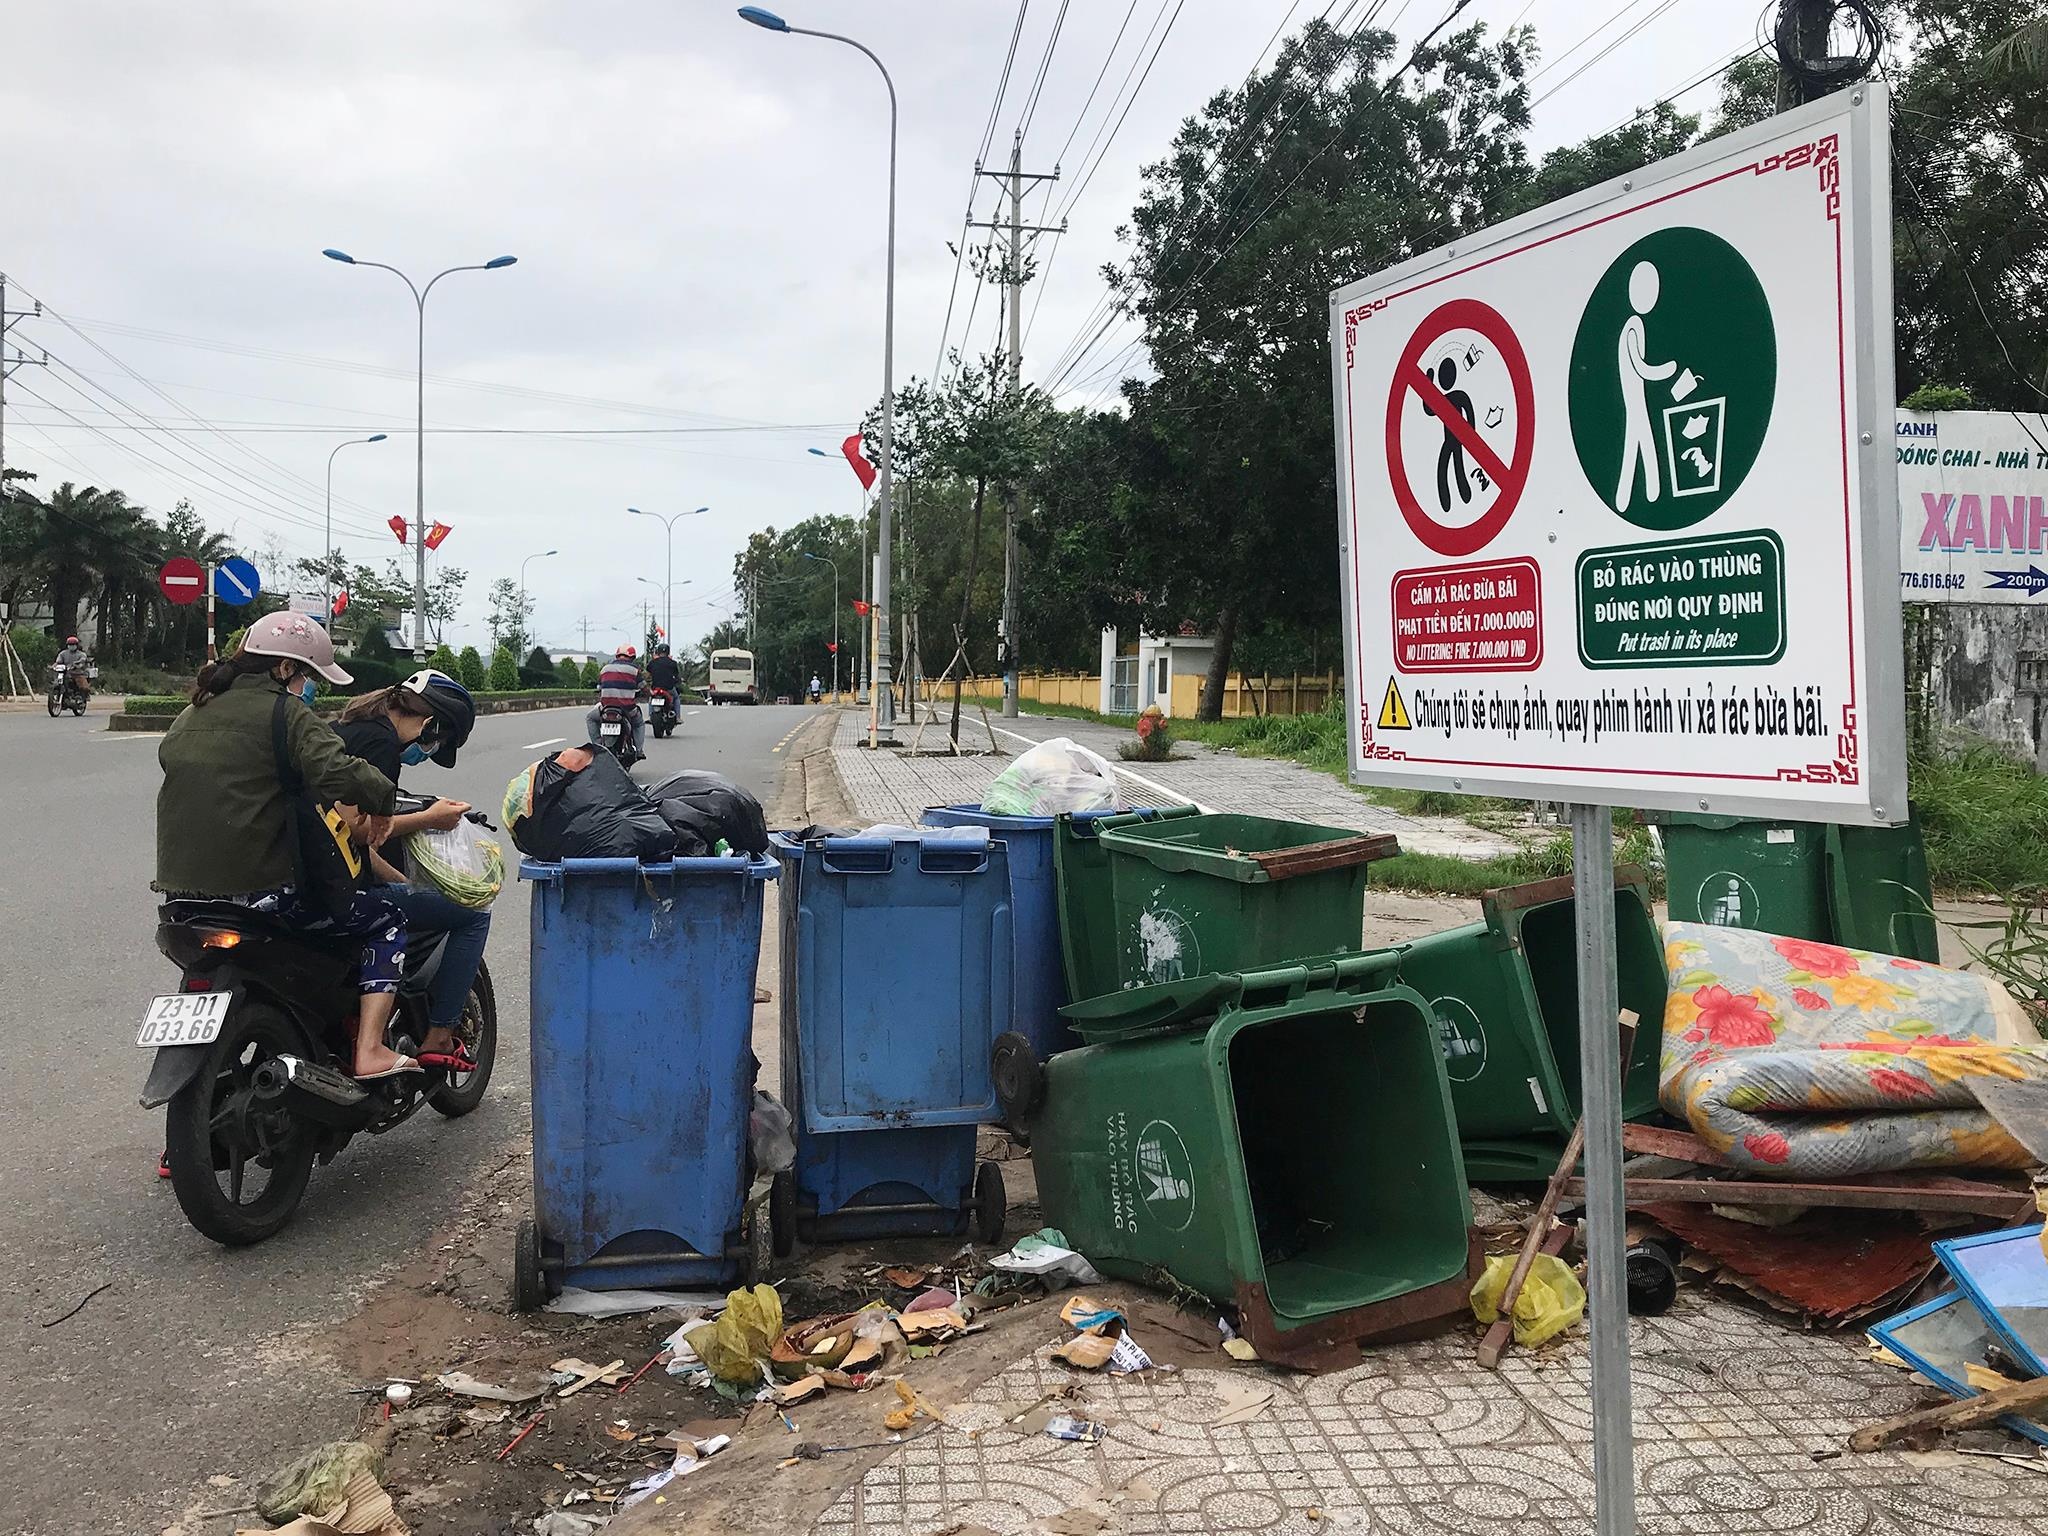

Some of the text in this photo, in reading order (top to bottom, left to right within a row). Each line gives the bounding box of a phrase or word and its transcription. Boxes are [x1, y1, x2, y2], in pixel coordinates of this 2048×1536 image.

[1942, 449, 1981, 467] CHAI
[1995, 447, 2028, 469] NHÀ
[1918, 492, 2048, 554] XANH
[1593, 550, 1762, 588] BỎ RÁC VÀO THÙNG
[2007, 575, 2046, 587] 200m
[1410, 575, 1518, 605] CẤM XẢ RÁC BỪA BÃI
[1594, 591, 1763, 623] ĐÚNG NƠI QUY ĐỊNH
[1398, 608, 1535, 639] PHẠT TIỀN ĐẾN 7.000.000Đ
[1406, 644, 1416, 661] NO
[1417, 643, 1454, 660] LITTERING!
[1454, 642, 1472, 659] FINE
[1472, 641, 1509, 658] 7.000.000
[1617, 627, 1739, 653] Put trash in its place
[1414, 681, 1828, 743] Chúng tôi sẽ chụp ảnh, quay phim hành vi xả rác bừa bãi.
[157, 995, 218, 1019] 23-D1
[141, 1019, 216, 1042] 033.66
